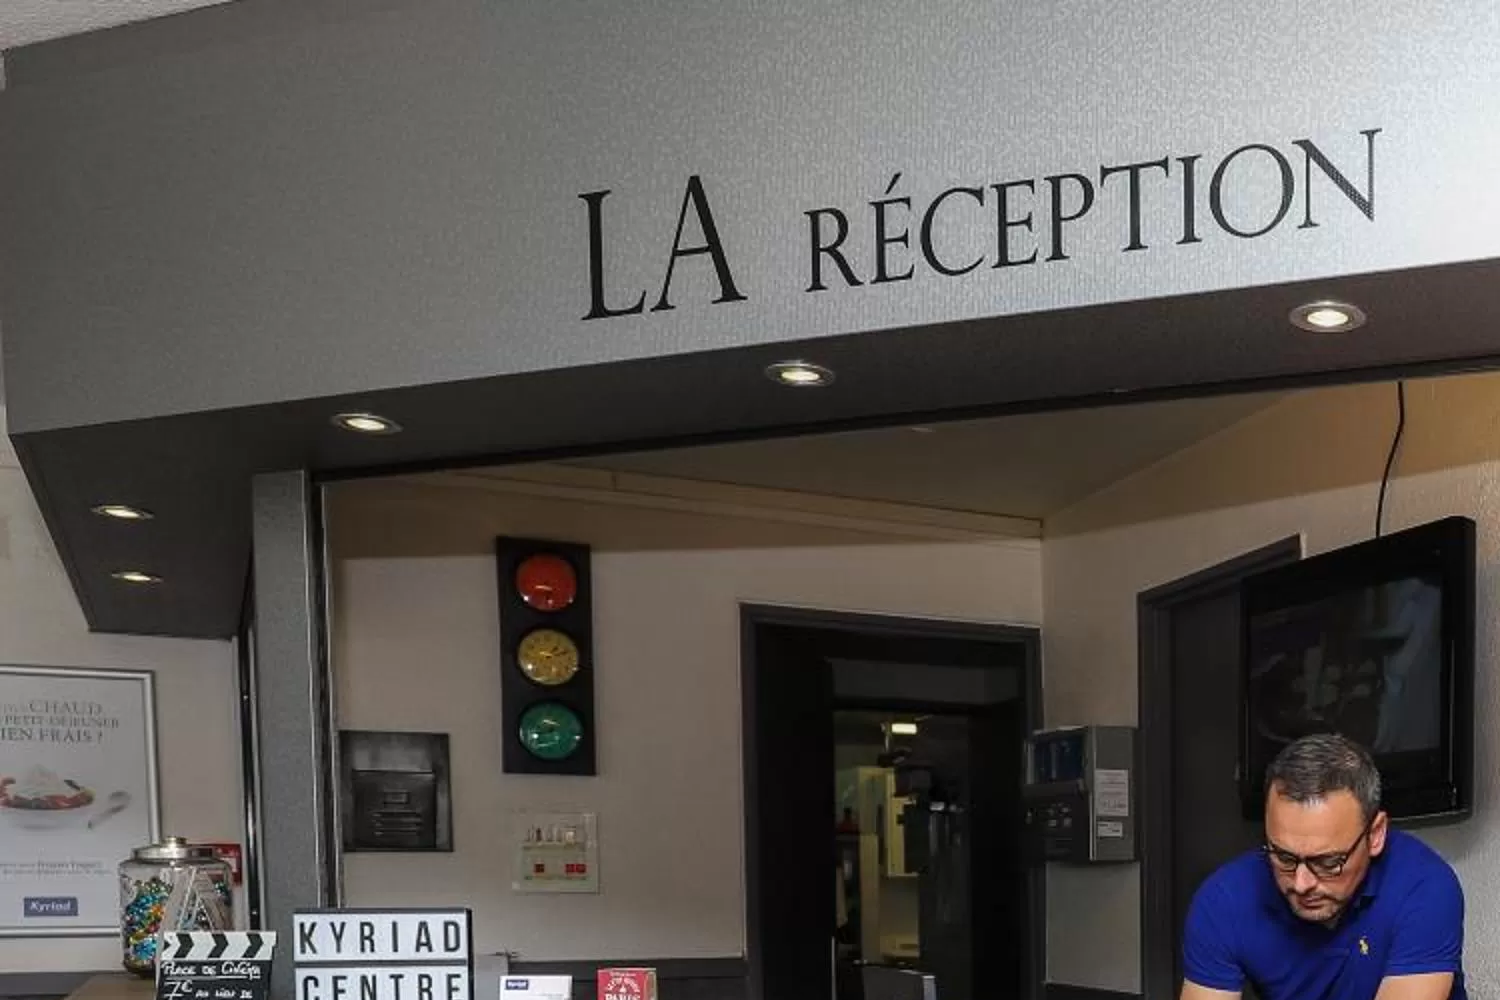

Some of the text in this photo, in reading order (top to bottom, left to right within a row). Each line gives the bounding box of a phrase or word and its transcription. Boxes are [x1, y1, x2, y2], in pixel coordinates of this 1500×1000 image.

[578, 127, 1383, 320] LA RÉCEPTION
[29, 900, 72, 913] Kyriad
[299, 920, 462, 954] KYRIAD
